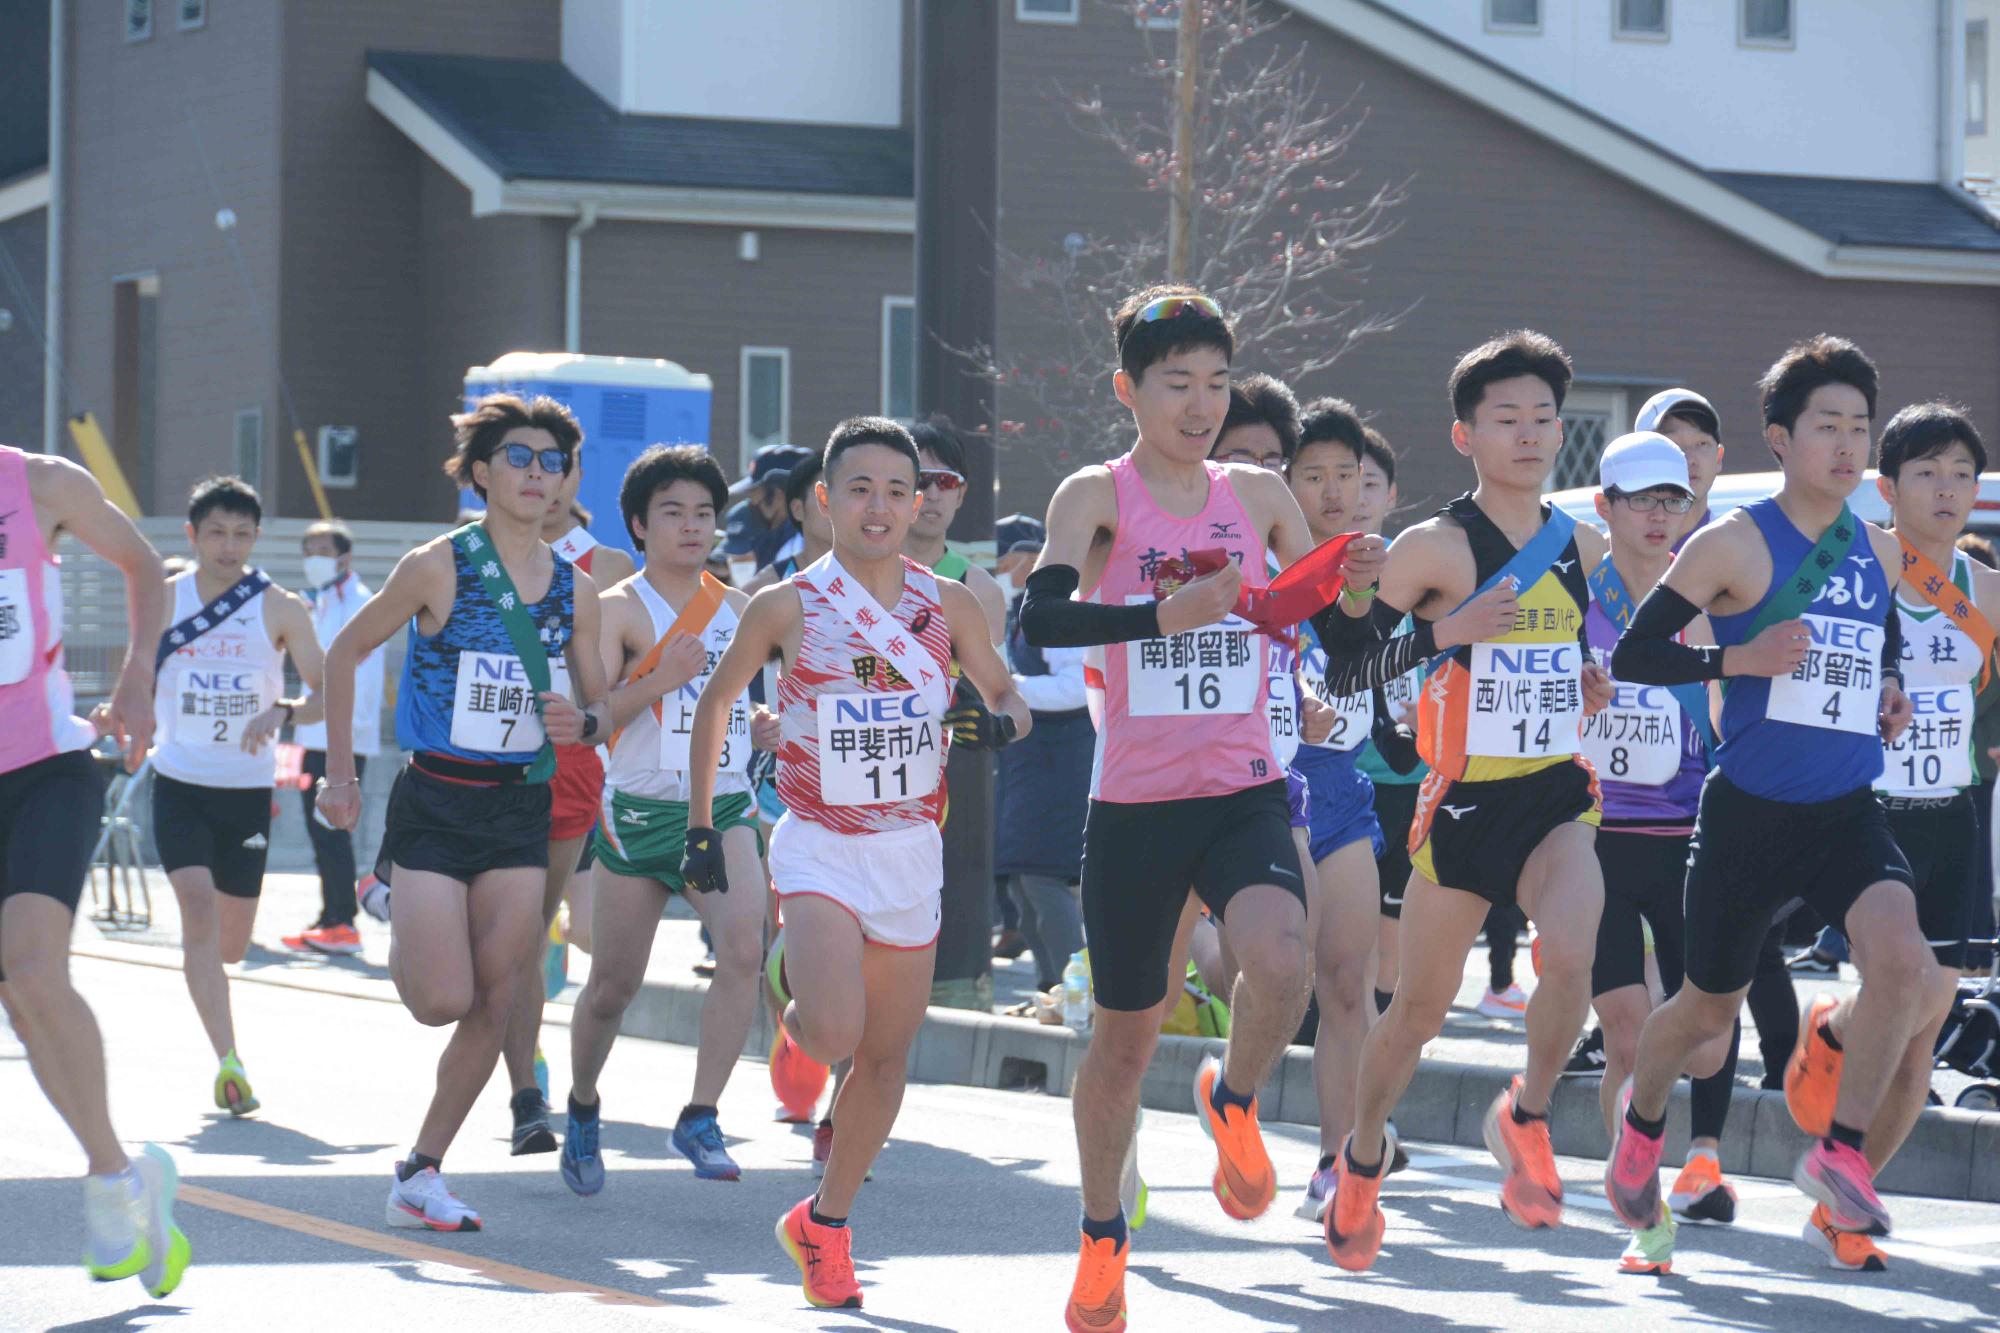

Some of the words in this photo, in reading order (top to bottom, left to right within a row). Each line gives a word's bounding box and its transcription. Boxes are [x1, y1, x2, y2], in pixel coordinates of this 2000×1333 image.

[827, 577, 935, 686] 甲斐市A
[1802, 619, 1874, 653] NEC
[1140, 630, 1251, 670] 南都留郡
[1490, 647, 1571, 674] NEC
[190, 672, 252, 692] NEC
[475, 657, 525, 682] NE
[182, 692, 259, 717] 富士吉田市
[1174, 673, 1221, 710] 16
[1610, 686, 1664, 710] EC
[1909, 689, 1960, 715] EC
[836, 693, 929, 723] NEC
[1822, 691, 1841, 724] 4
[213, 720, 228, 742] 2
[500, 719, 517, 748] 7
[831, 721, 934, 762] 甲斐市A
[1512, 719, 1551, 753] 14
[1249, 758, 1268, 778] 19
[1609, 746, 1629, 776] 8
[1902, 754, 1942, 786] 10
[865, 763, 907, 799] 11
